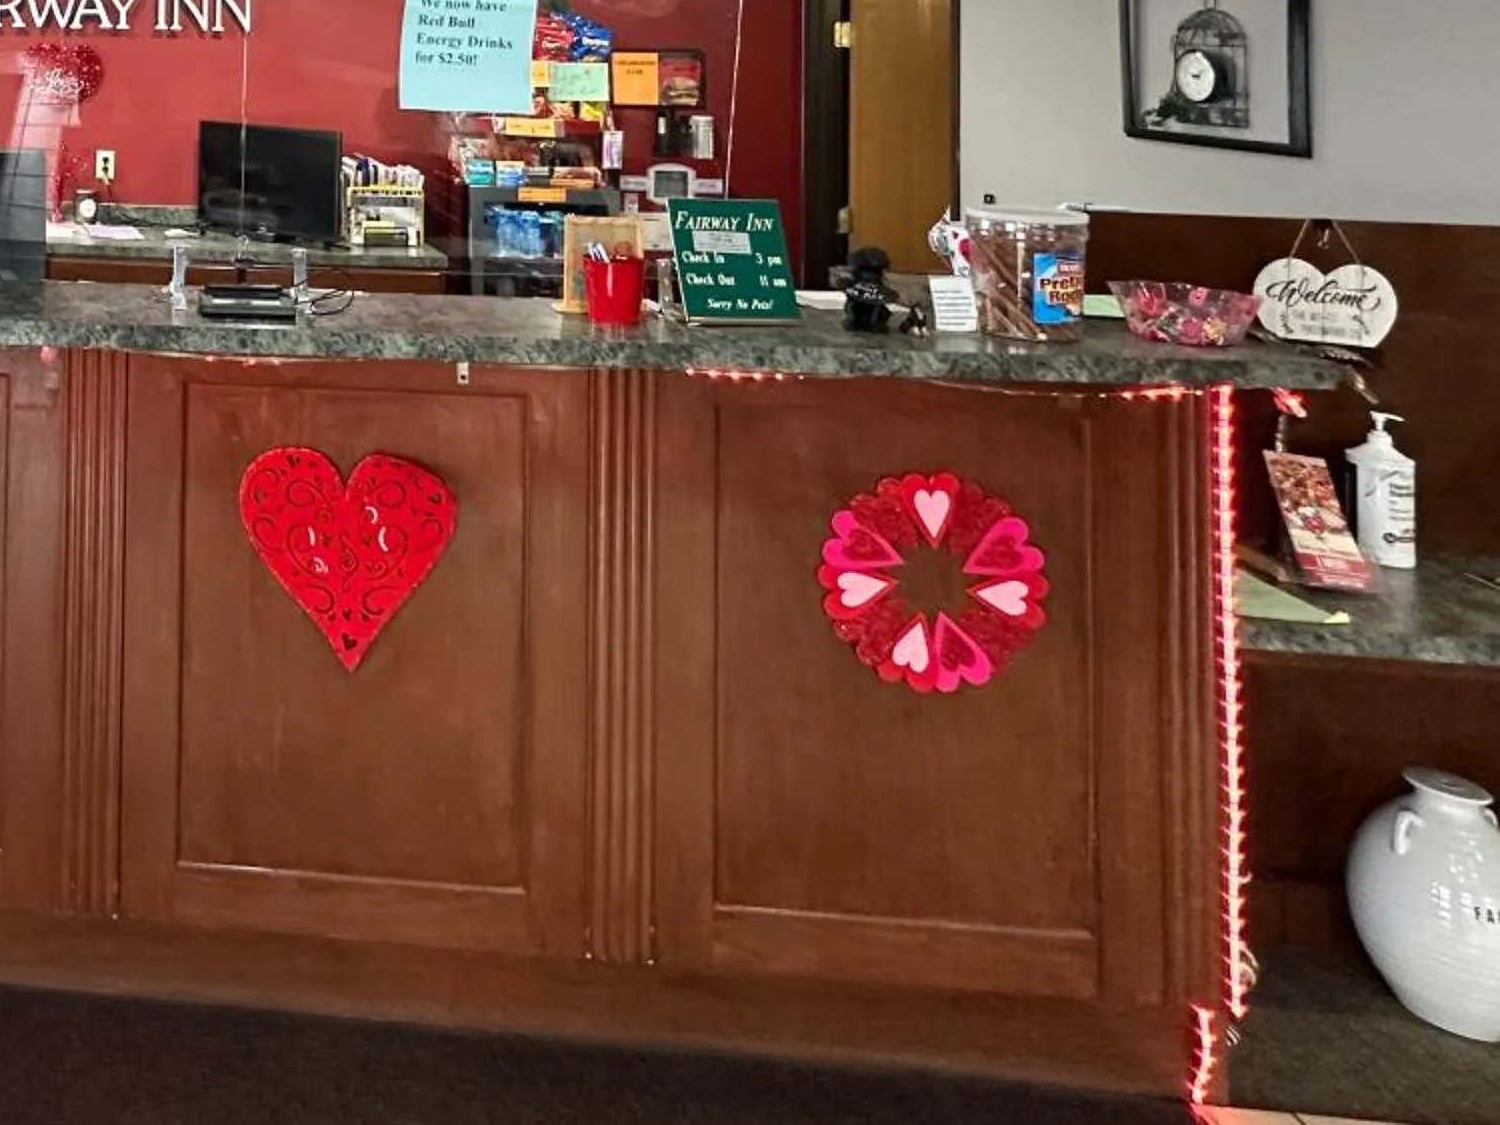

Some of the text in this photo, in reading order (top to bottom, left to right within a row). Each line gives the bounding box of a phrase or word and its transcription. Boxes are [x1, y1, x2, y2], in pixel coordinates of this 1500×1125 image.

[445, 0, 471, 9] now
[475, 0, 508, 12] have
[418, 14, 476, 28] Red Bull
[417, 32, 514, 50] Energy Drinks
[415, 51, 478, 65] for $2.50!
[675, 210, 774, 231] FAIRWAY INN
[681, 250, 711, 264] Check
[714, 251, 725, 264] In
[756, 252, 764, 264] 3
[686, 272, 715, 286] Check
[718, 274, 736, 286] Out
[1265, 277, 1381, 312] Welcome
[707, 298, 732, 311] Sorry
[736, 299, 749, 309] No
